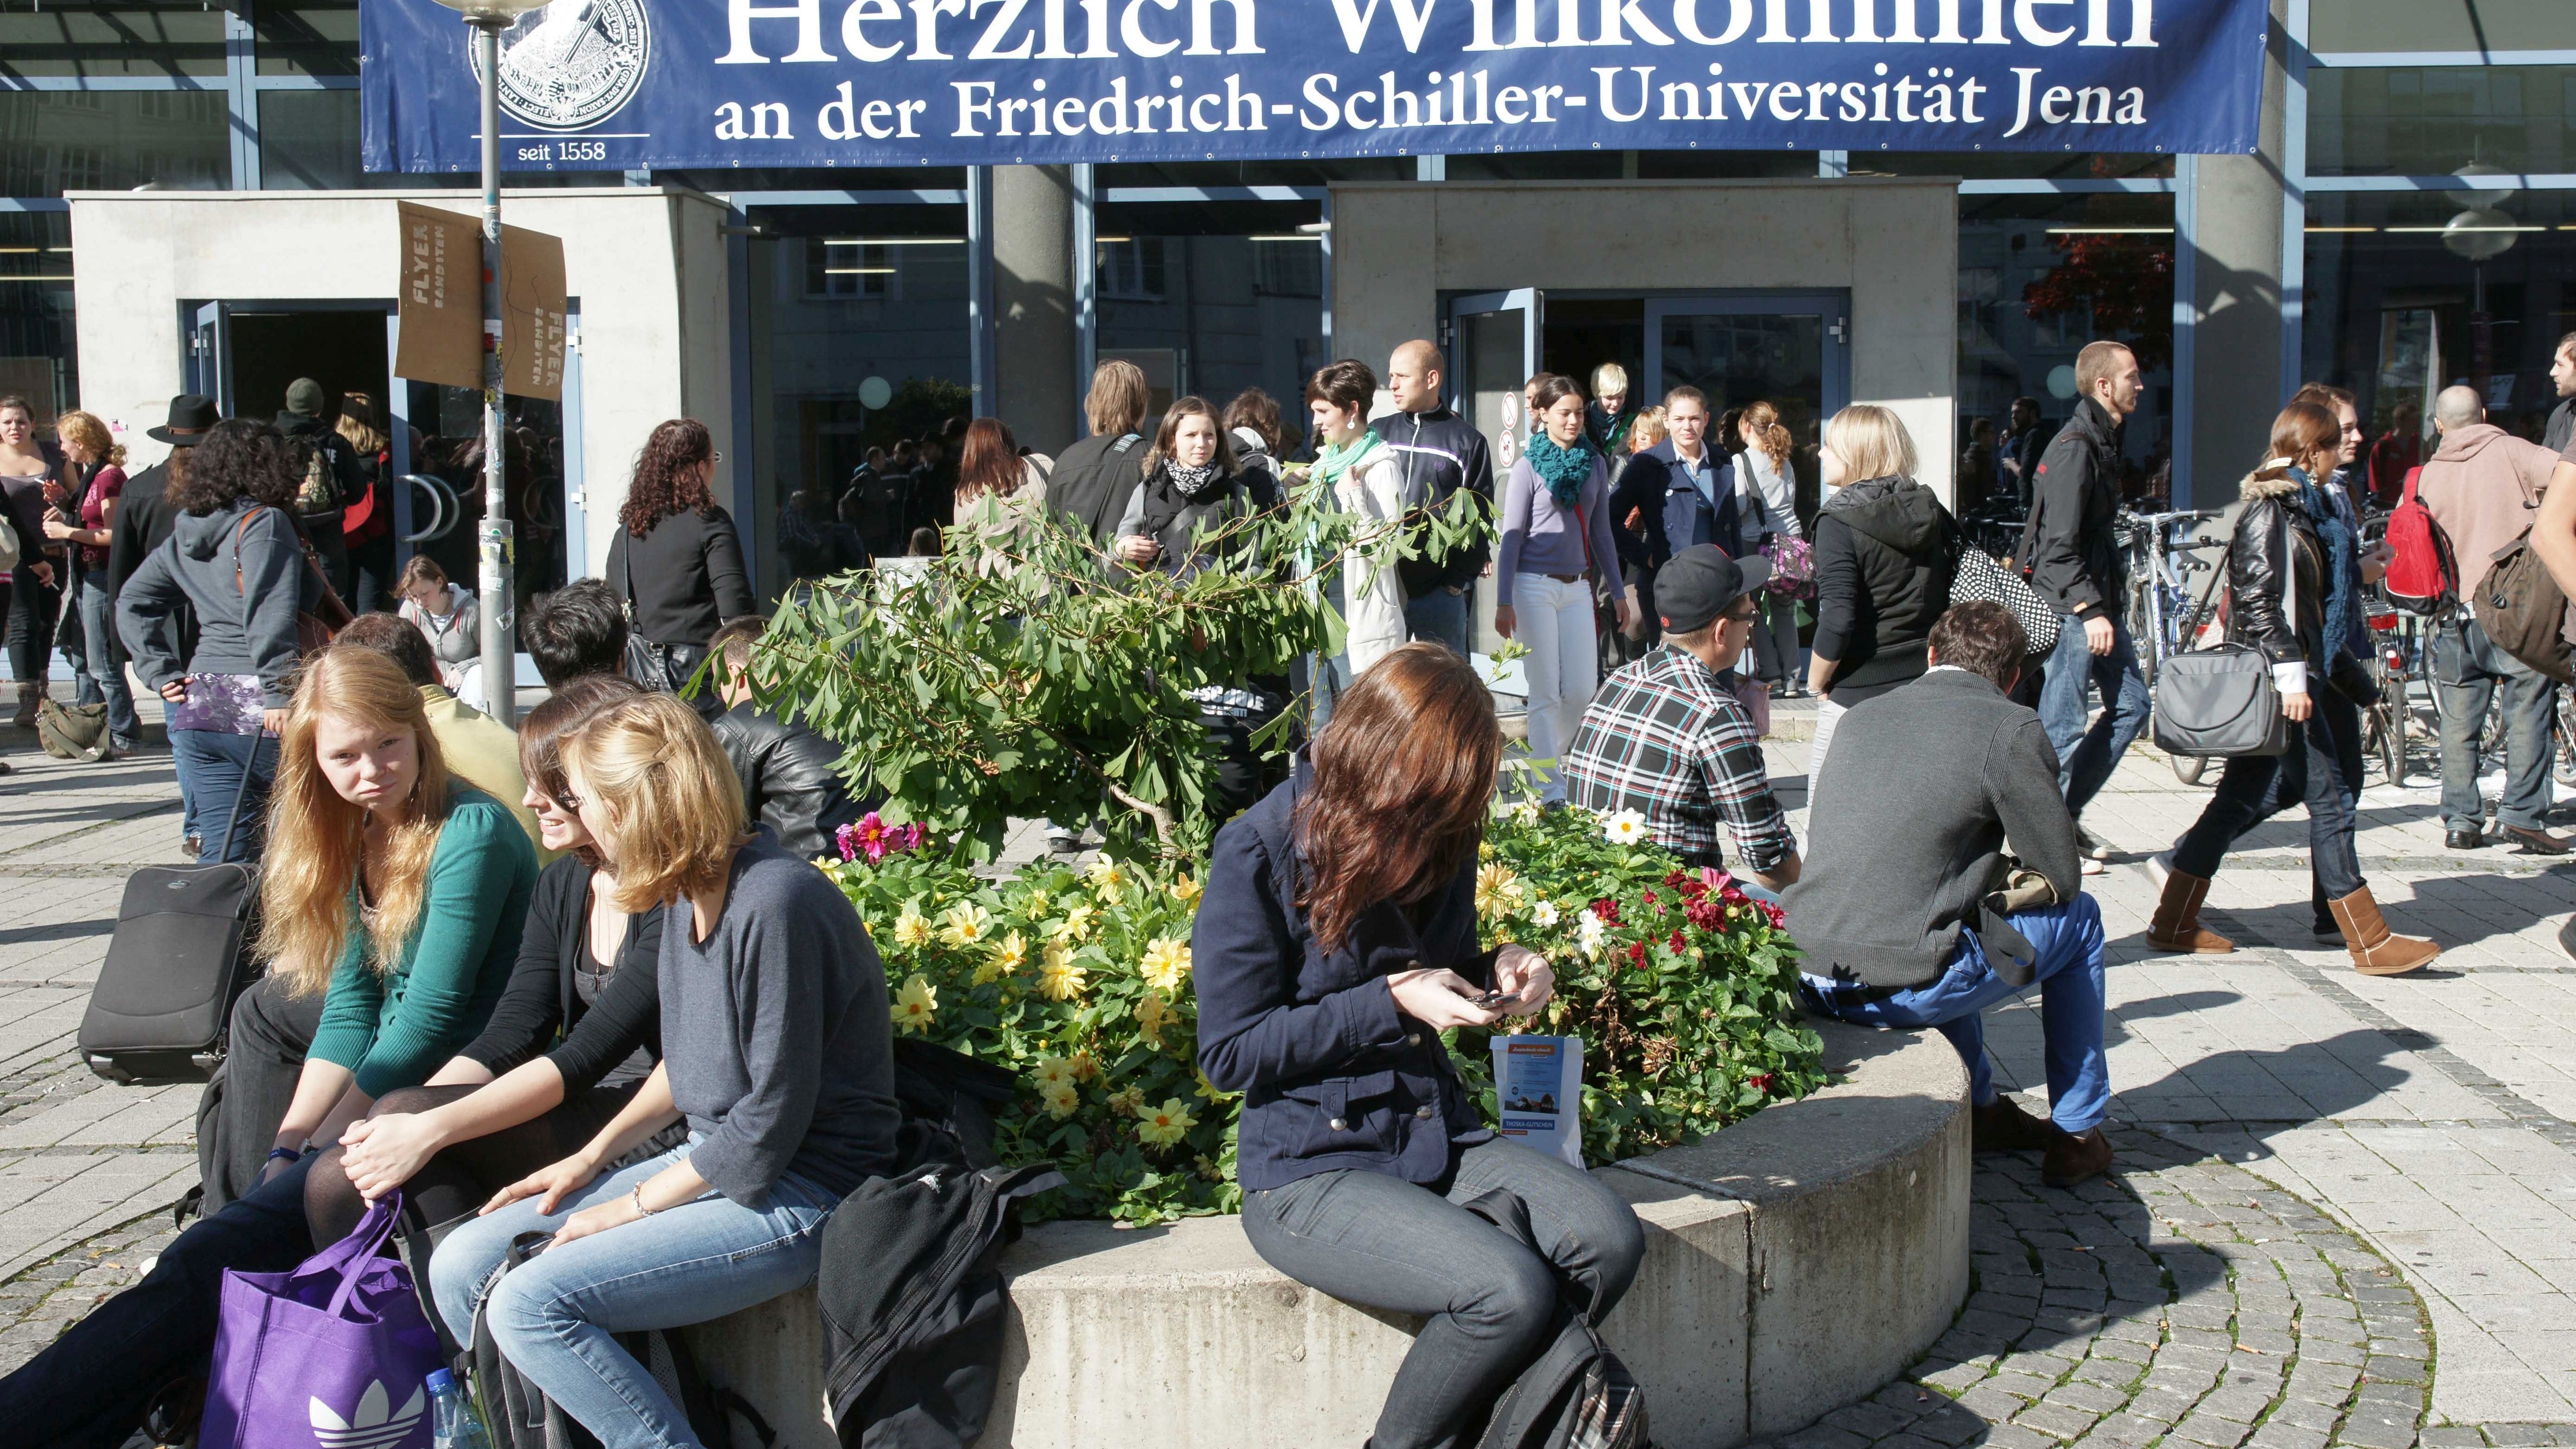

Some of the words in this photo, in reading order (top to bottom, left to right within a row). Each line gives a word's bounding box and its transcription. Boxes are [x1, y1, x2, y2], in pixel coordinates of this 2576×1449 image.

[715, 0, 1266, 64] Herzlich
[715, 102, 794, 140] an
[818, 81, 927, 140] der
[950, 66, 1956, 137] Friedrich-Schiller-Universität
[2003, 68, 2147, 138] Jena
[518, 145, 550, 160] seit
[558, 142, 606, 160] 1558
[413, 224, 430, 304] FLYER
[546, 311, 563, 386] FLYER
